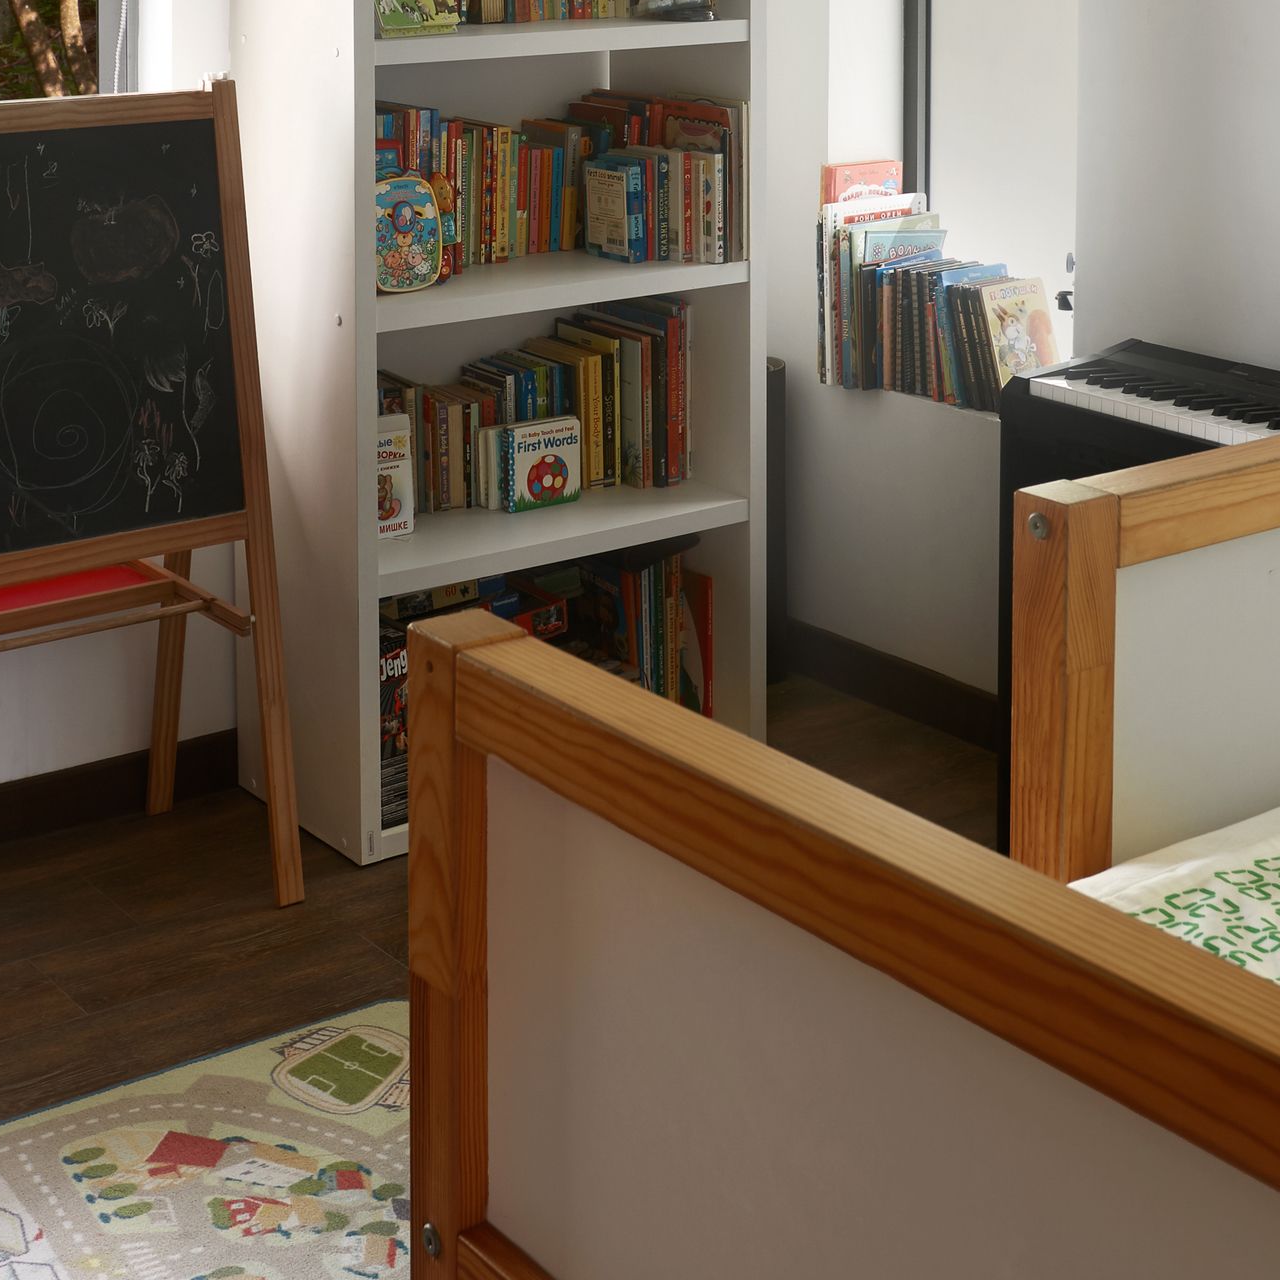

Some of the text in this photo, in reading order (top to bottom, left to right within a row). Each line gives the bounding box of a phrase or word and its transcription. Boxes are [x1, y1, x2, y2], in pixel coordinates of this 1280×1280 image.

[607, 171, 624, 183] animals
[509, 179, 517, 204] Smile
[854, 209, 902, 223] РОНИ ОРЕН
[660, 221, 669, 256] СКАЗКИ
[841, 318, 849, 342] Bible
[604, 394, 613, 423] Space
[528, 431, 540, 439] Baby
[592, 417, 600, 438] Body
[517, 433, 578, 454] First Words
[379, 520, 409, 534] МИШКЕ
[444, 585, 457, 598] 60
[380, 648, 408, 682] Jeng
